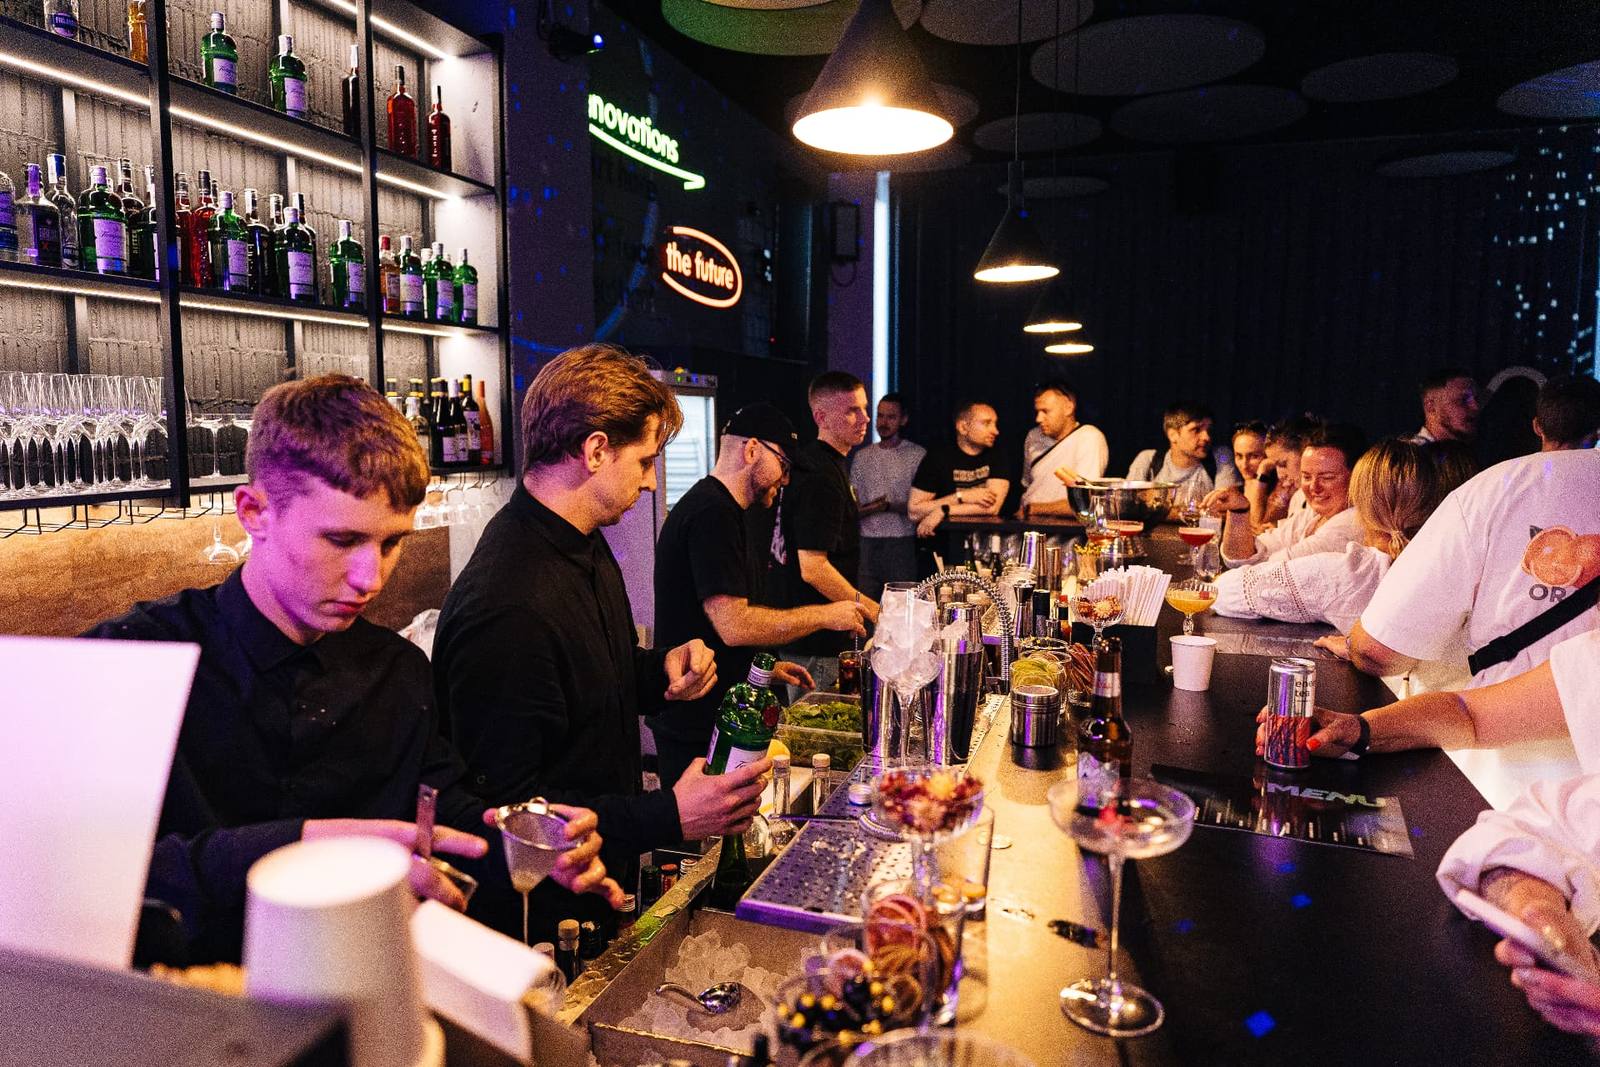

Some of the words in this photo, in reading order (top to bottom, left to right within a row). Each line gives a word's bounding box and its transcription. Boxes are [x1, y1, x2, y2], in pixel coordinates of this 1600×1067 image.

[666, 241, 692, 277] the
[694, 250, 734, 290] future
[1267, 782, 1387, 808] MENU
